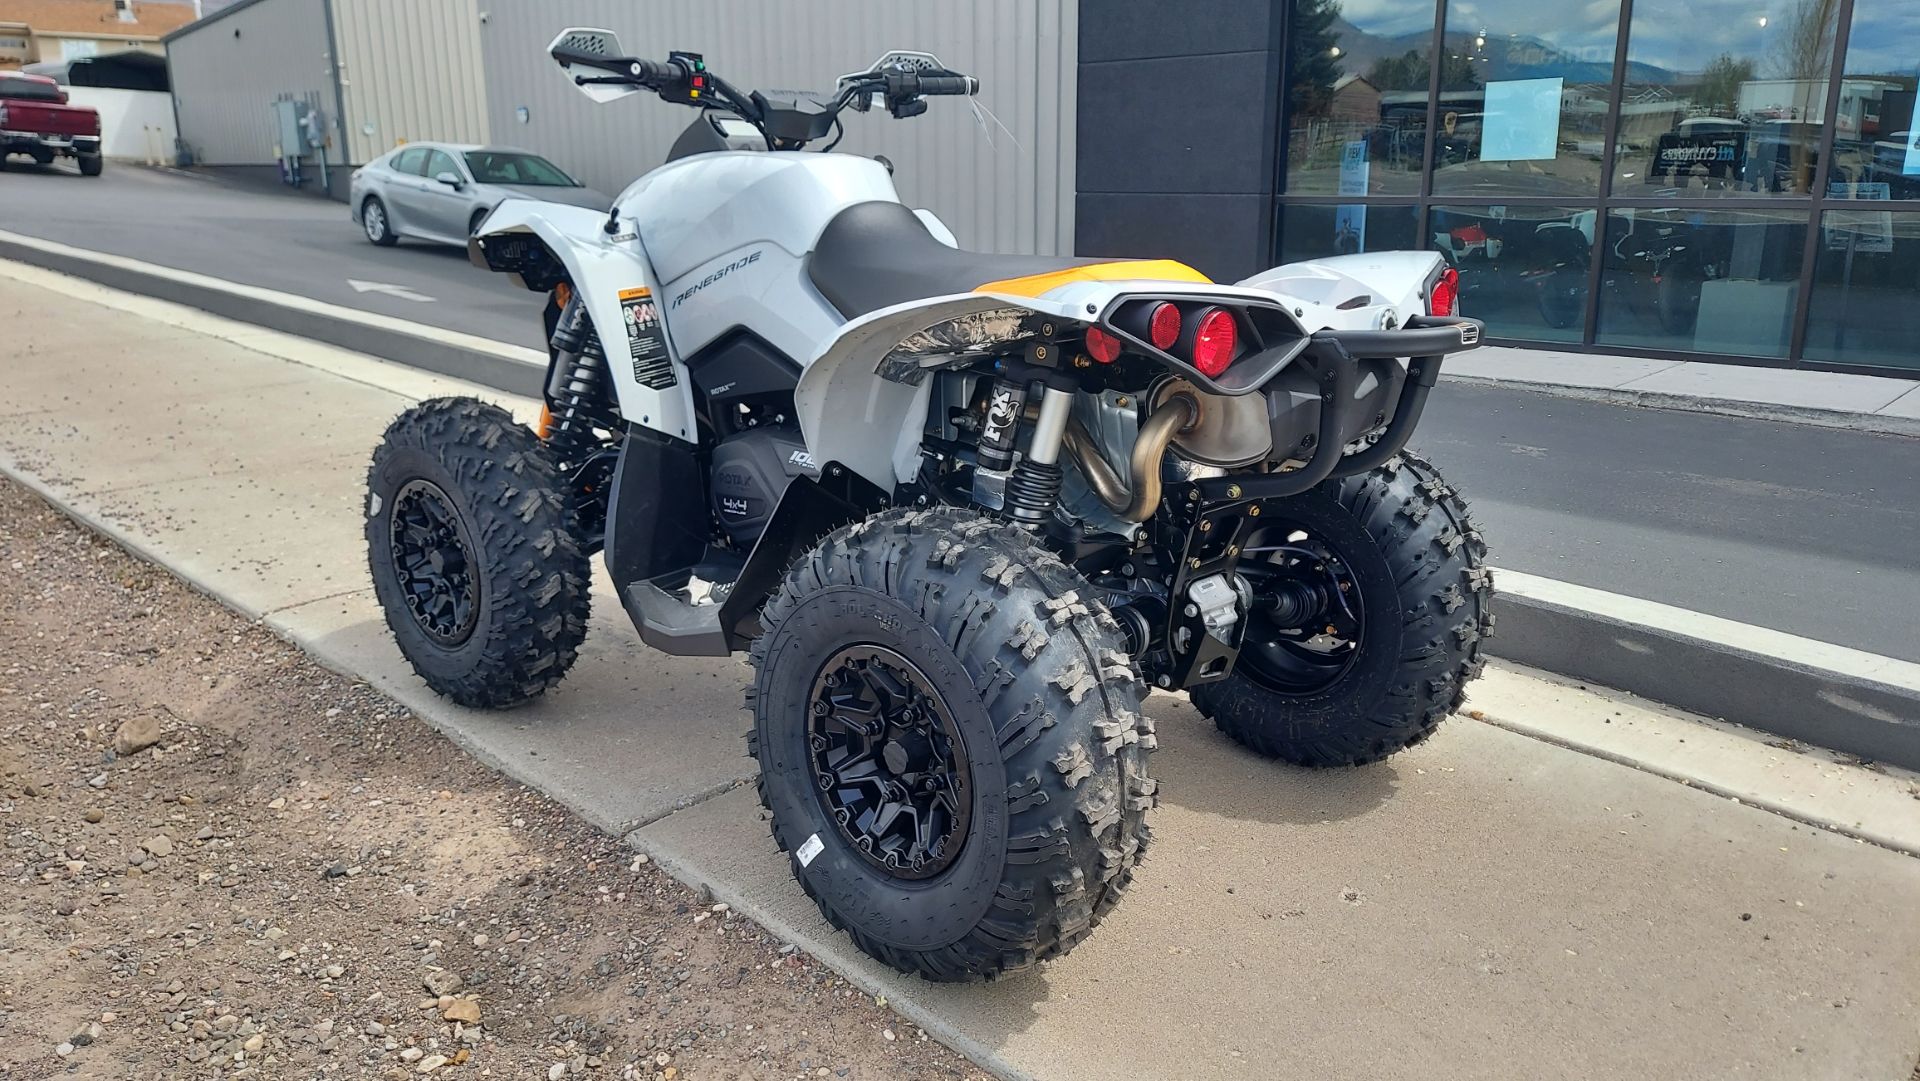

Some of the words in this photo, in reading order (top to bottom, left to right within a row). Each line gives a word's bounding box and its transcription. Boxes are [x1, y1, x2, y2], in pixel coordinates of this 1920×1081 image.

[672, 250, 762, 310] RENEGADE
[983, 387, 1019, 442] FOX
[723, 497, 747, 511] 4x4
